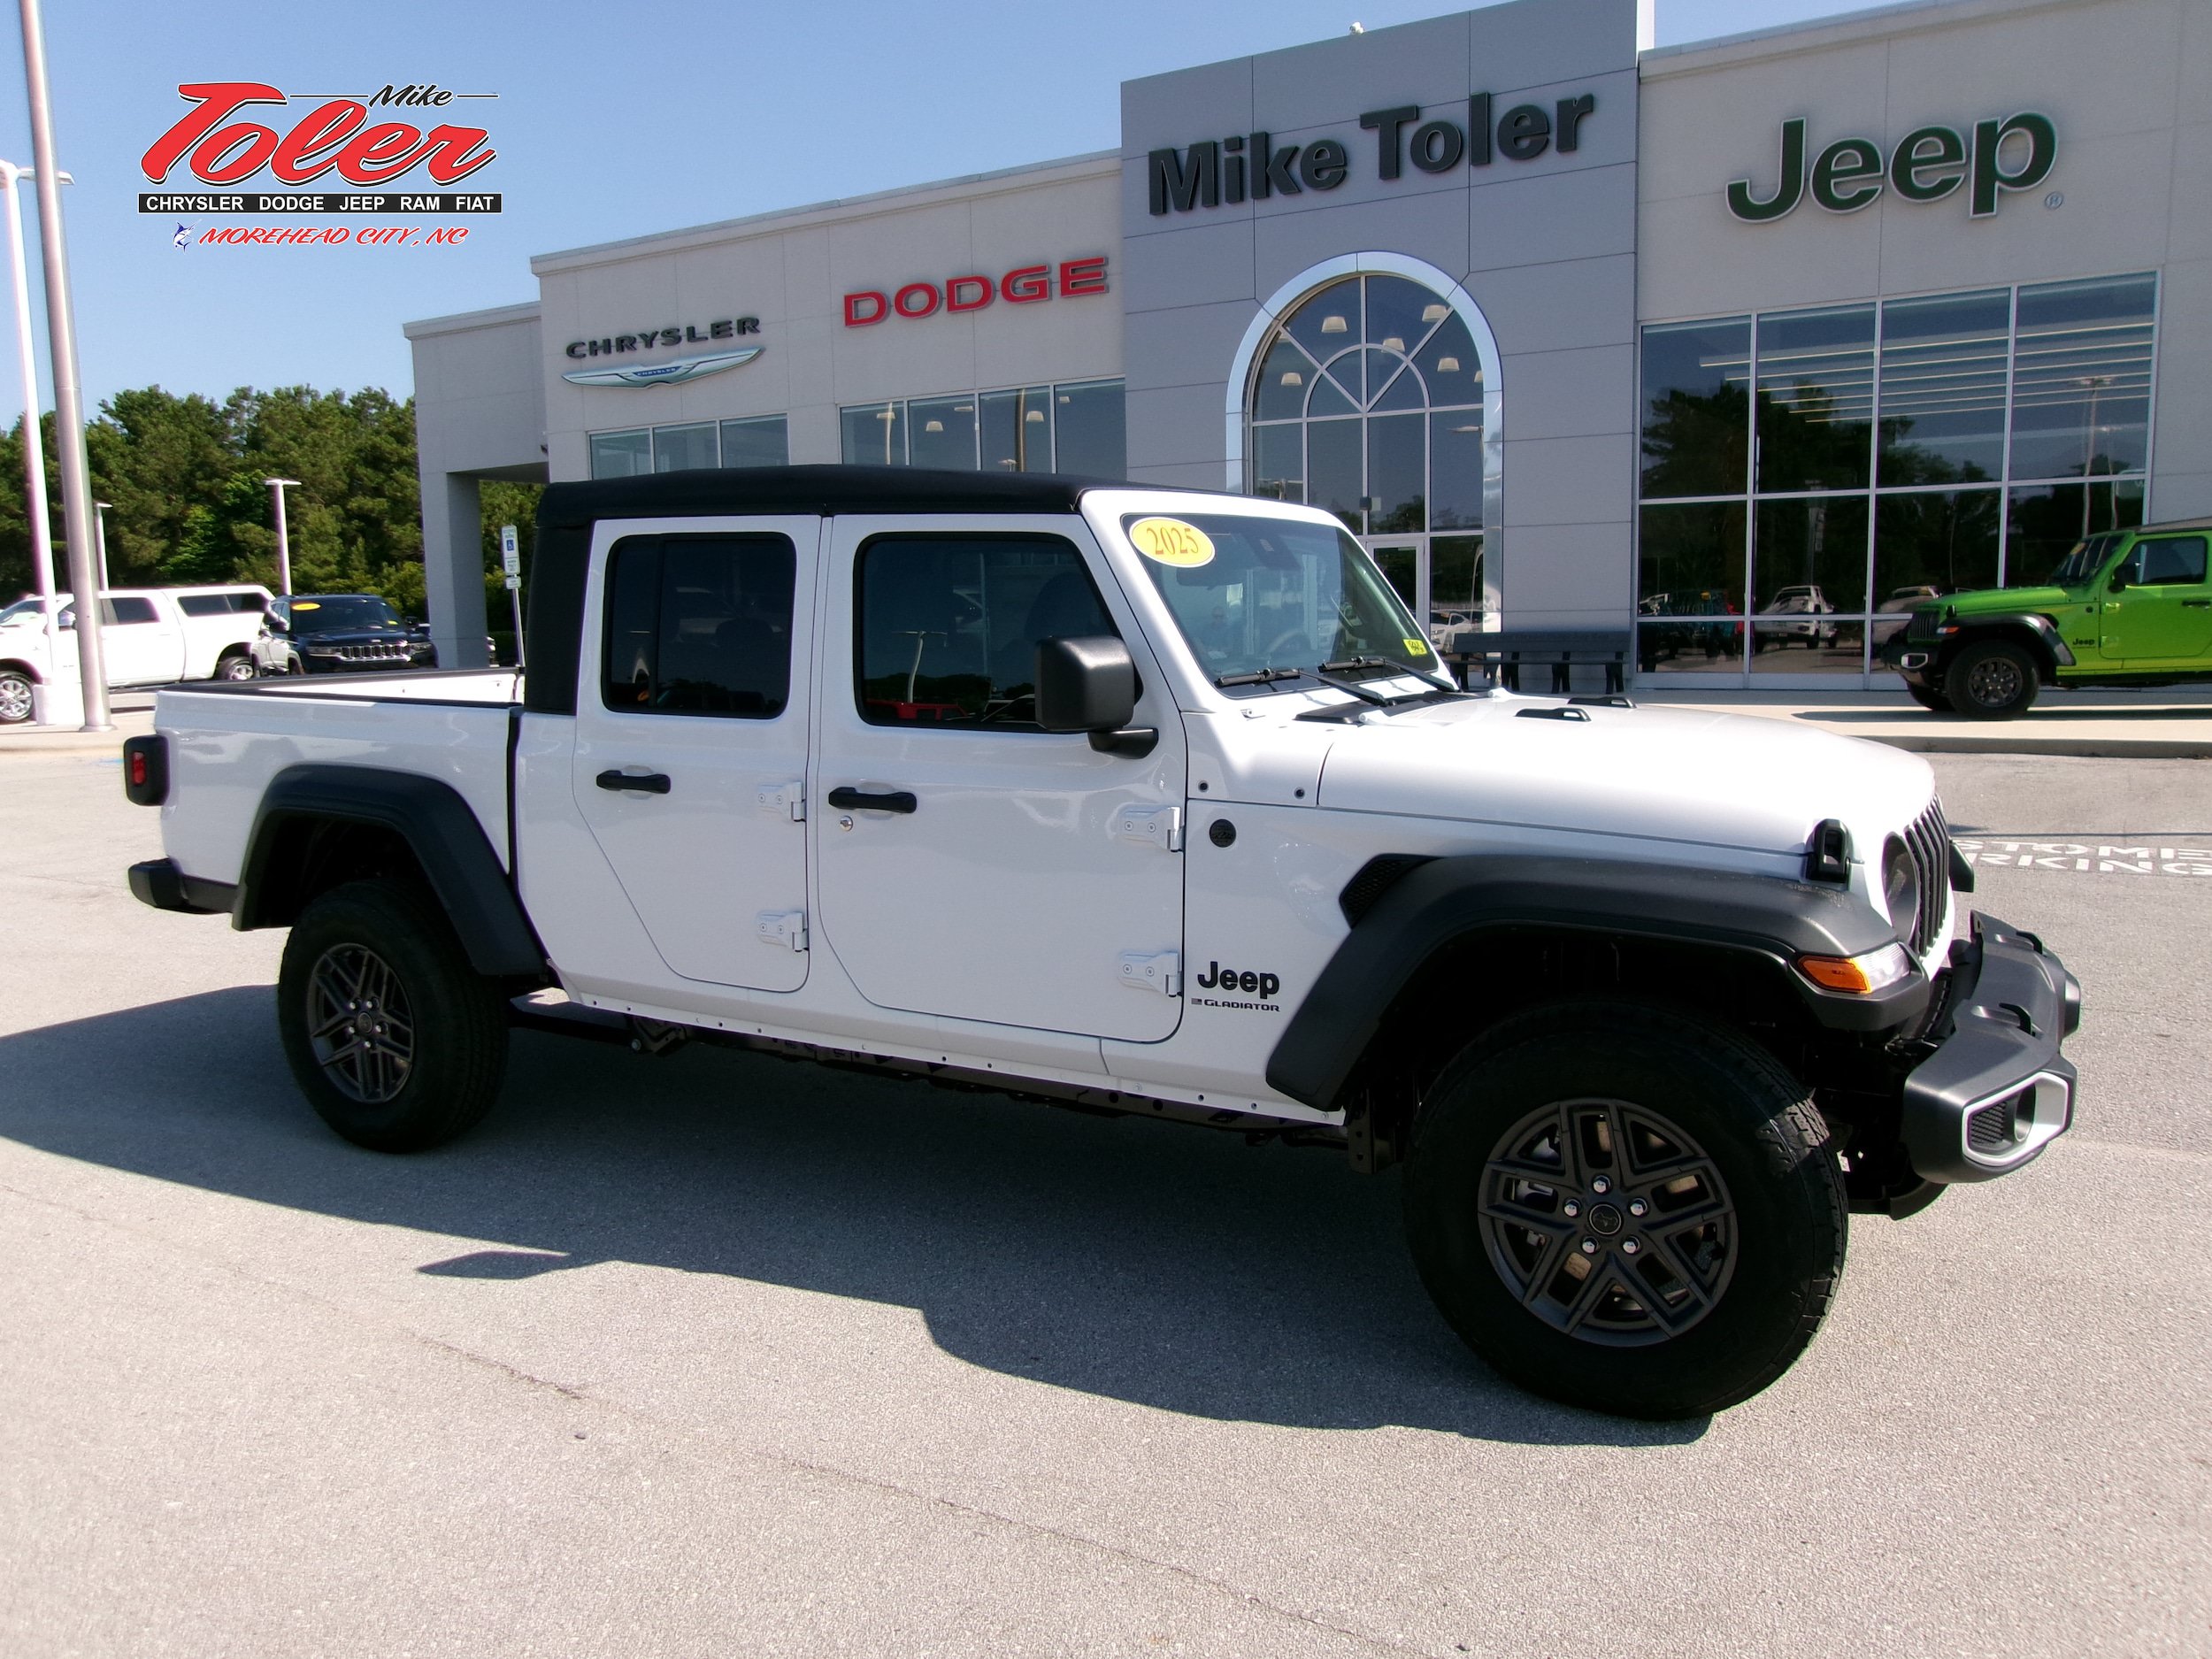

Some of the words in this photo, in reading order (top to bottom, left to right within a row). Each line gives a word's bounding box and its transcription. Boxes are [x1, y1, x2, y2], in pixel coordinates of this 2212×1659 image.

[1148, 131, 1348, 216] Mike
[1359, 91, 1595, 180] Toler
[1725, 111, 2057, 224] Jeep
[843, 256, 1107, 328] DODGE
[565, 317, 761, 360] CHRYSLER
[1146, 526, 1199, 556] 2025
[1964, 853, 2212, 875] RKING
[1197, 961, 1279, 1000] Jeep
[1203, 999, 1280, 1012] GLADIATOR
